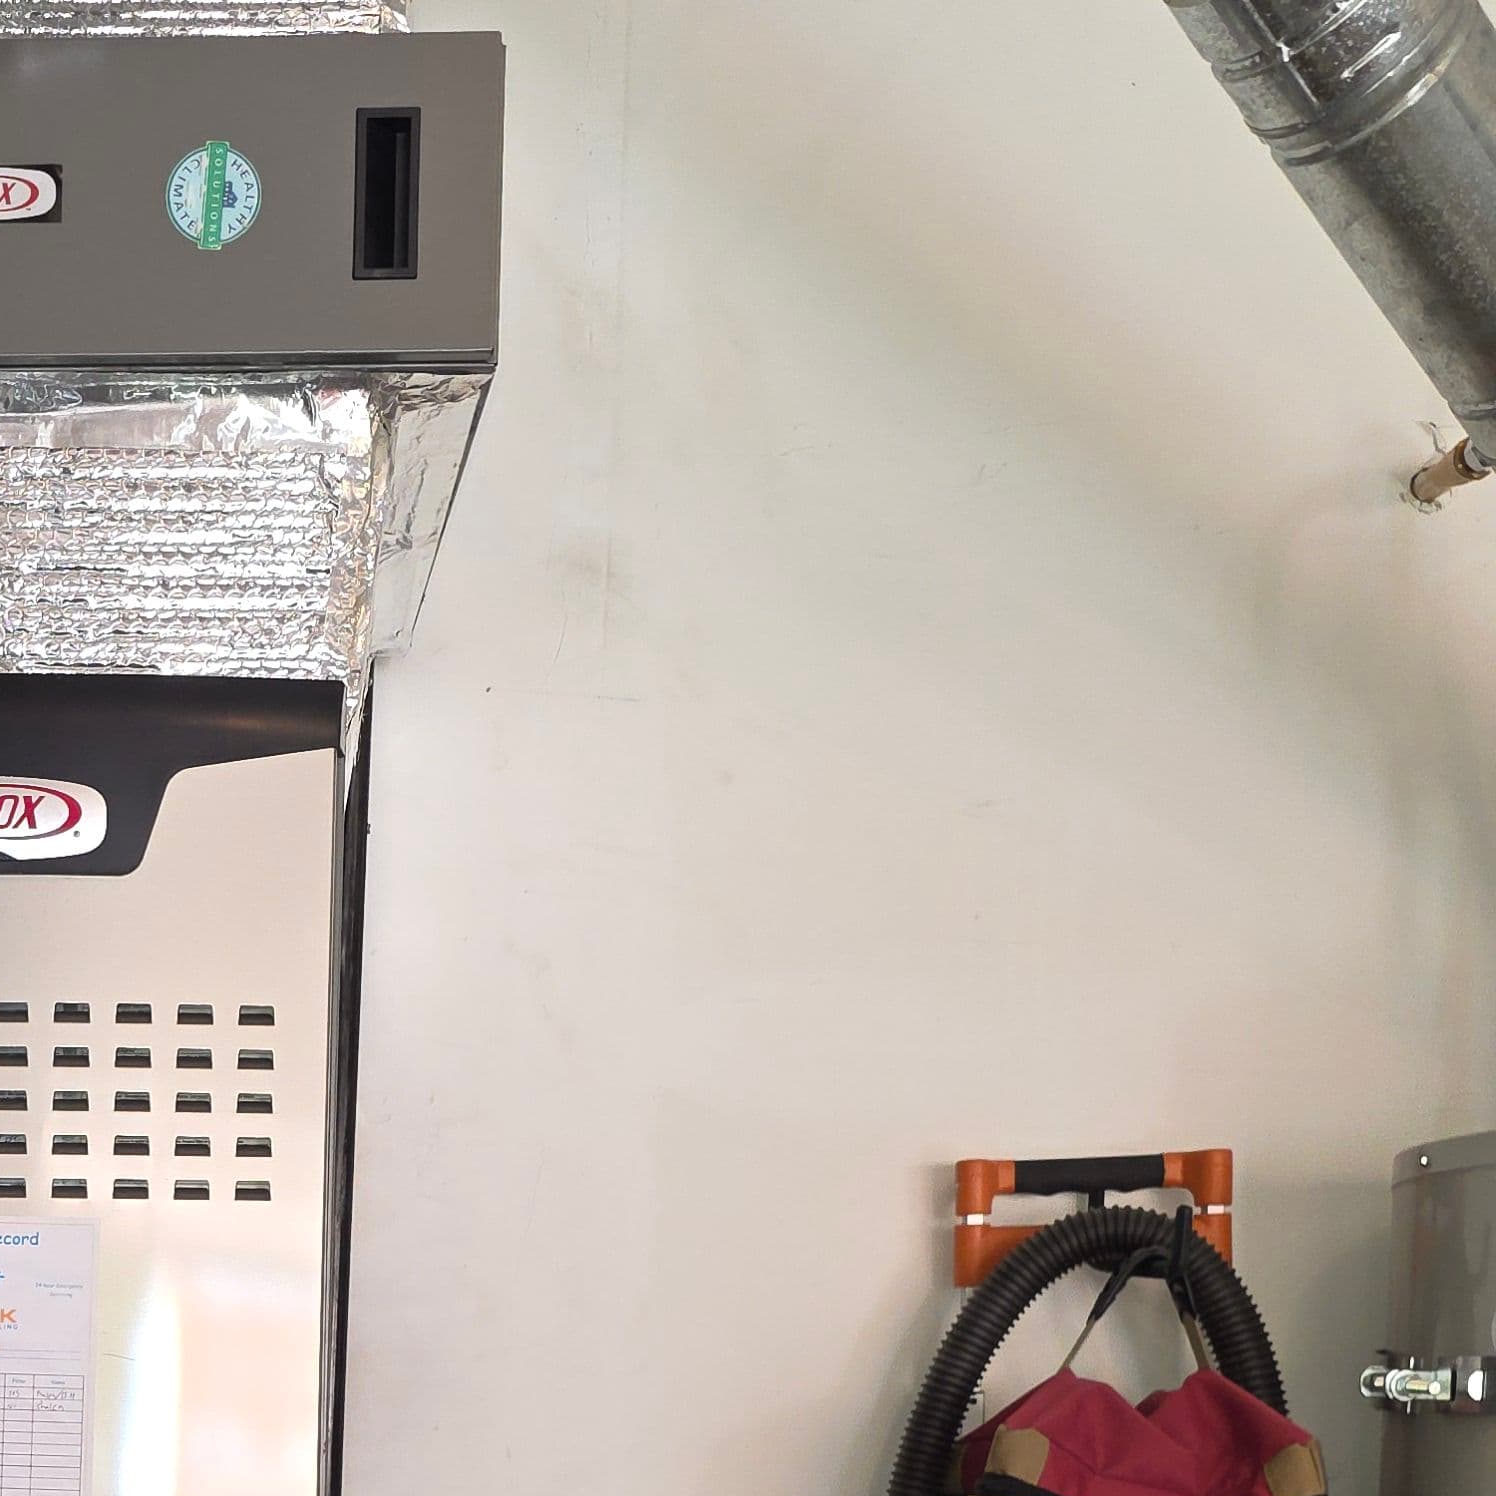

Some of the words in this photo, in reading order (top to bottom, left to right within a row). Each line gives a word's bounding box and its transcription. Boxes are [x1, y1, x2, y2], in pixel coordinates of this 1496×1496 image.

[172, 158, 202, 231] CLIMATE
[207, 147, 224, 242] SOLUTIONS
[230, 158, 255, 234] HEALTHY
